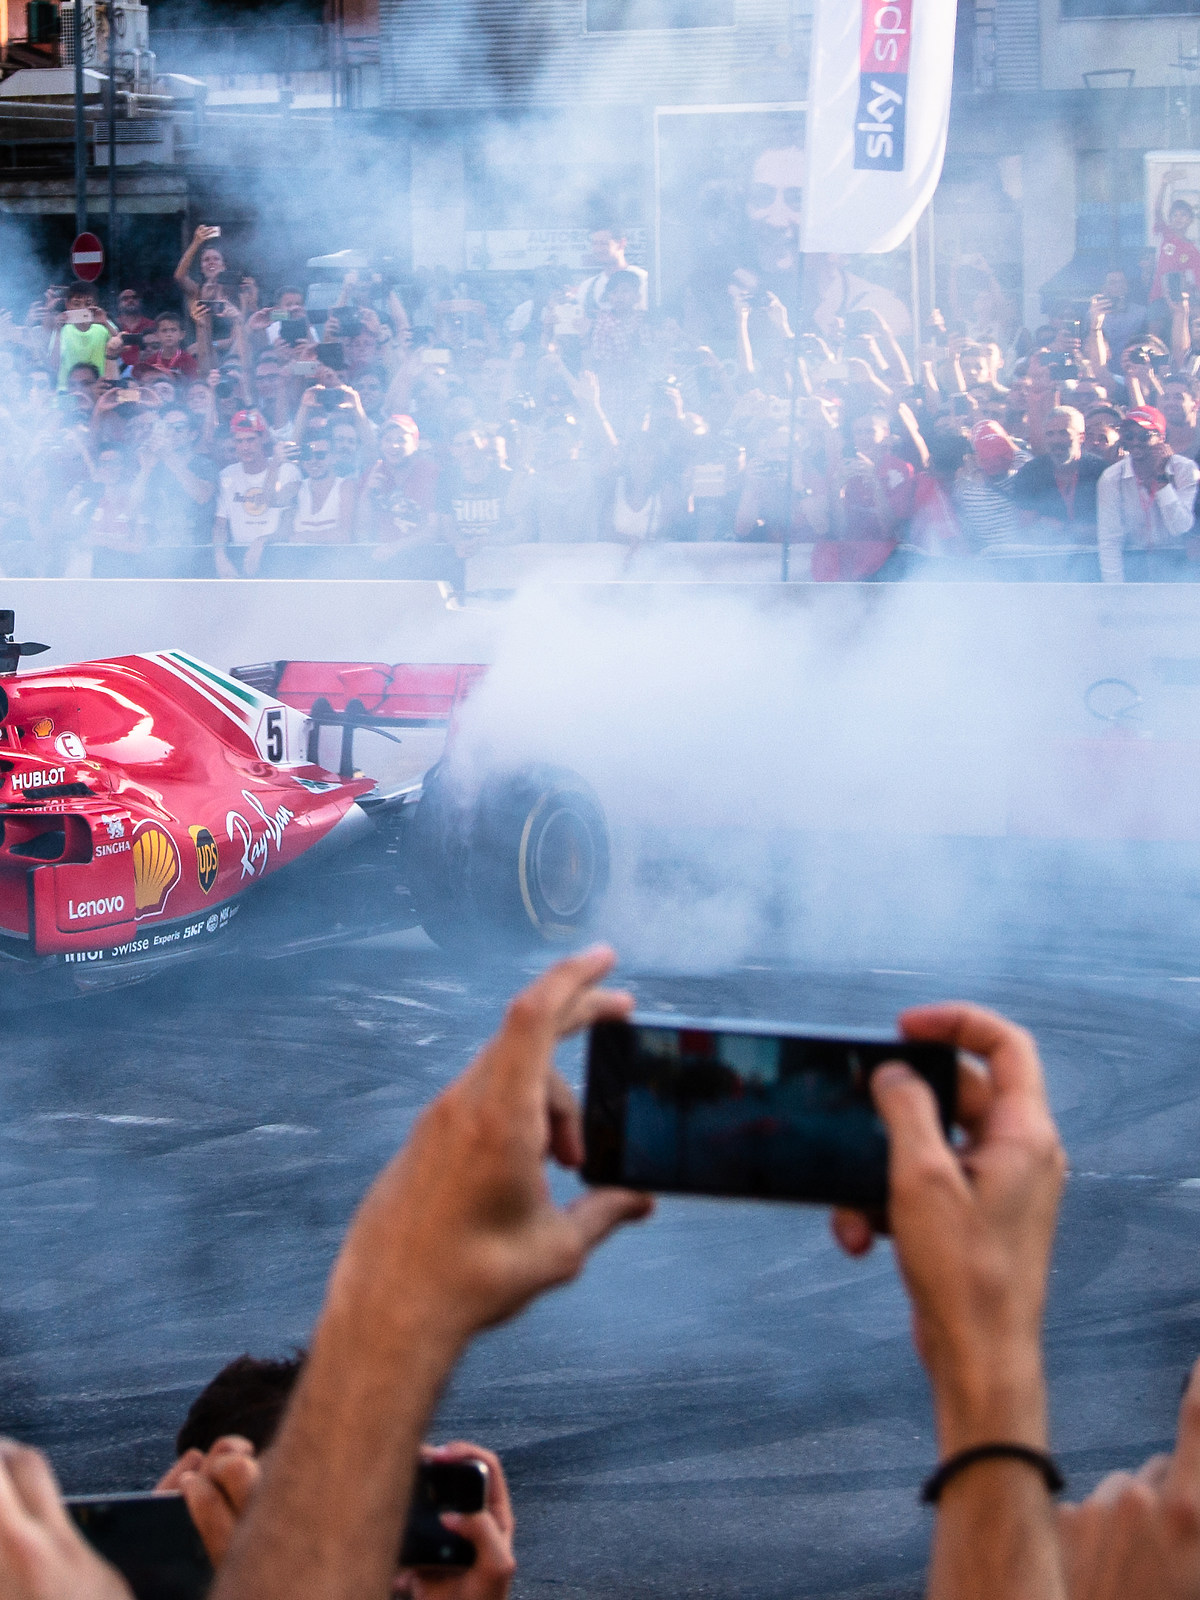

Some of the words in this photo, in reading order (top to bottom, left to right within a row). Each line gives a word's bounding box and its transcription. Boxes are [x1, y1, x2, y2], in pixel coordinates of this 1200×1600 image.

[873, 0, 907, 62] sp
[857, 80, 904, 158] sky
[61, 735, 81, 757] E
[267, 710, 284, 763] 5
[11, 766, 66, 790] HUBLOT
[95, 840, 132, 857] SINGHA
[197, 844, 218, 884] ups
[68, 895, 125, 920] Lenovo
[153, 931, 181, 946] Experis
[183, 921, 205, 939] SKF
